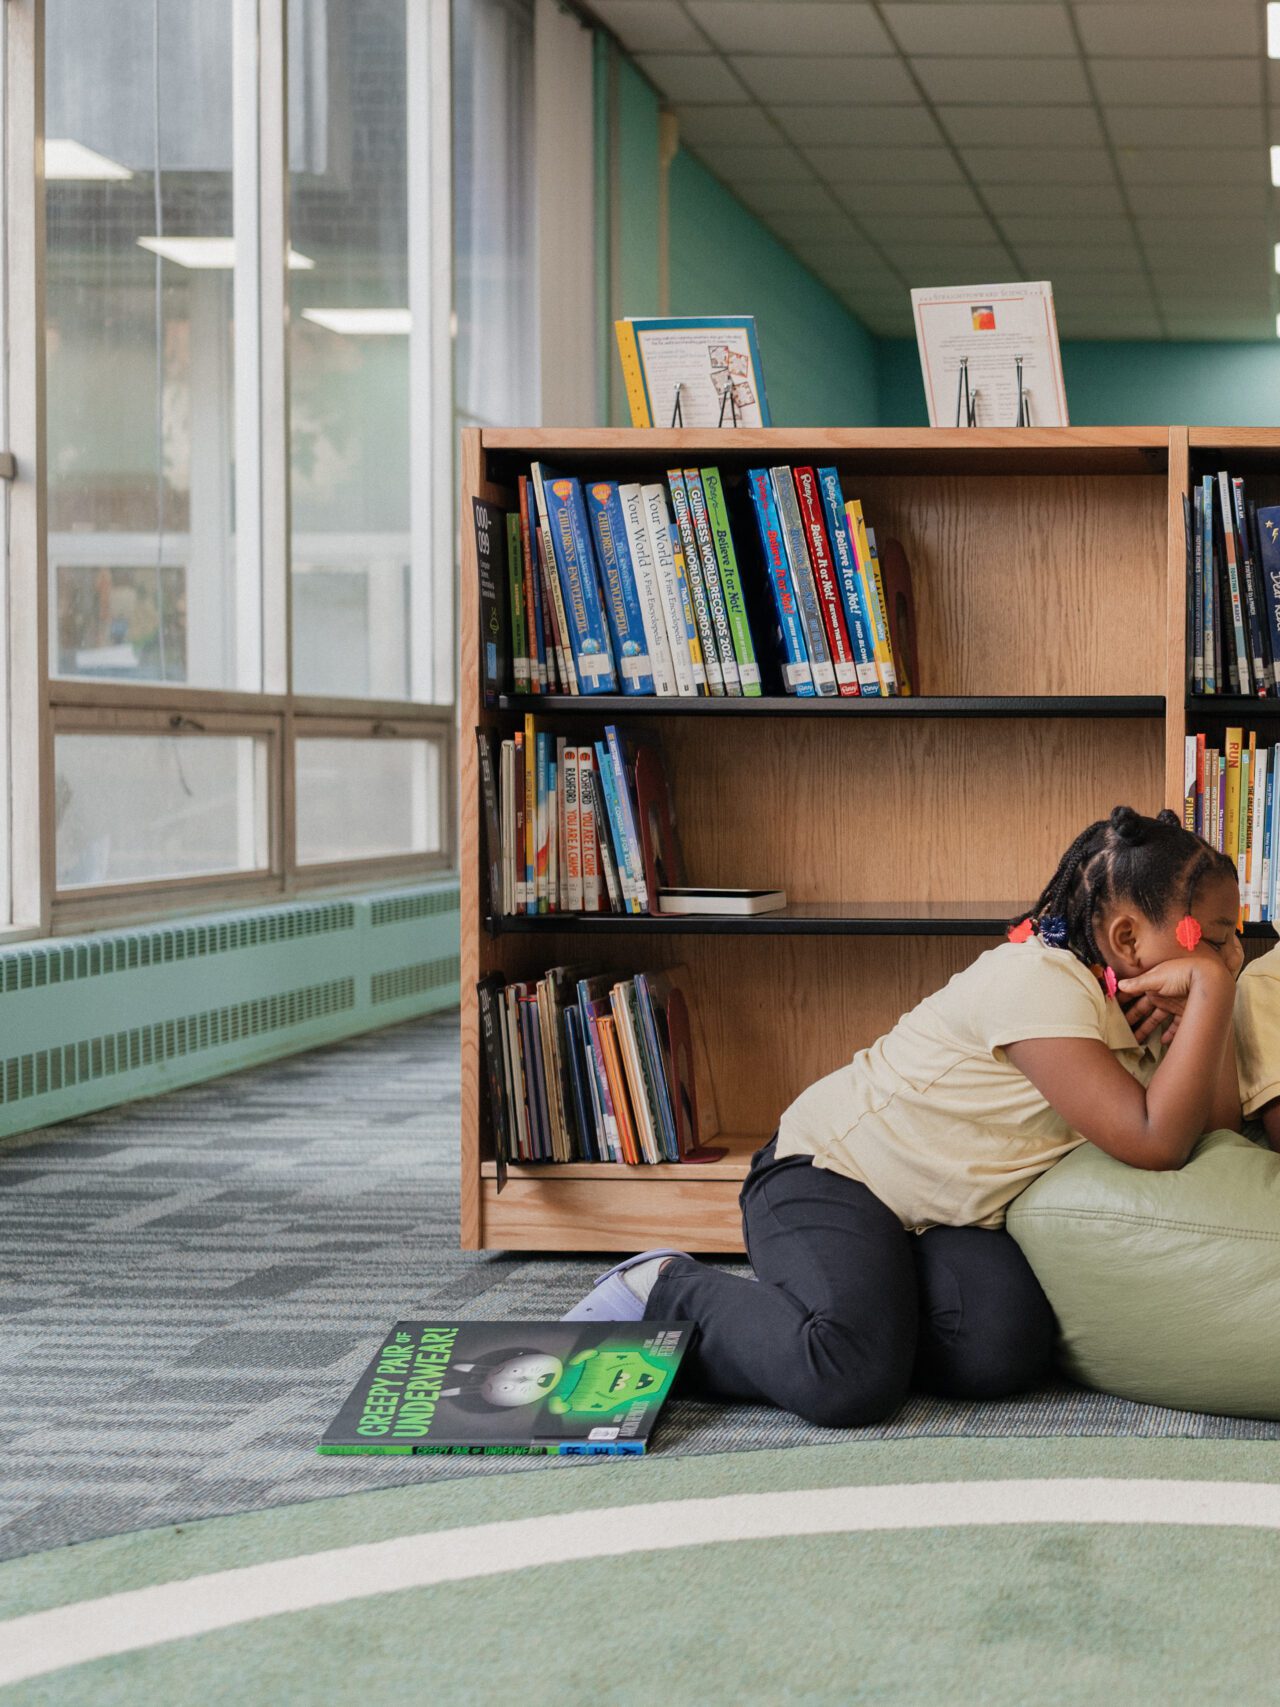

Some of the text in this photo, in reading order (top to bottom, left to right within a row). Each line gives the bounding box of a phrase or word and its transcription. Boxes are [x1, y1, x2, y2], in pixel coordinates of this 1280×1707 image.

[627, 494, 640, 525] Your
[649, 493, 661, 525] Your
[674, 490, 692, 545] GUINNESS
[543, 531, 557, 576] SCHOMBURG
[633, 527, 652, 568] World
[654, 527, 673, 567] World
[717, 529, 730, 566] Believe
[810, 523, 824, 560] Believe
[834, 530, 849, 567] Believe
[558, 508, 588, 634] CHILDREN'S ENCYCLOPEDIA
[598, 511, 628, 637] CHILDREN'S ENCYCLOPEDIA
[685, 544, 700, 585] WORLD
[692, 489, 711, 545] GUINNESS
[702, 544, 718, 586] WORLD
[710, 586, 729, 638] RECORDS
[724, 568, 735, 582] It
[767, 529, 796, 615] Believe It or Not!
[817, 560, 829, 574] It
[821, 573, 830, 583] or
[842, 567, 854, 582] It
[644, 579, 653, 596] First
[666, 579, 675, 595] First
[822, 581, 837, 601] Not!
[845, 581, 854, 592] or
[692, 586, 712, 637] RECORDS
[728, 592, 744, 614] Not!
[828, 603, 838, 627] BEYOND
[846, 592, 862, 614] Not!
[648, 596, 661, 646] Encyclopedia
[669, 596, 682, 646] Encyclopedia
[854, 620, 863, 639] MIND
[1229, 742, 1239, 769] RUN
[565, 768, 576, 804] RASHFORD
[566, 810, 577, 827] YOU
[583, 810, 593, 827] YOU
[614, 806, 626, 835] CONSENT
[567, 828, 577, 844] ARE
[584, 829, 594, 844] ARE
[356, 1332, 416, 1436] CREEPY PAIR OF
[392, 1328, 459, 1437] UNDERWEAR!
[416, 1446, 449, 1455] CREEPY
[452, 1446, 469, 1455] PAIR
[484, 1446, 543, 1455] UNDERWEAR!
[567, 1446, 637, 1455] R E Y
